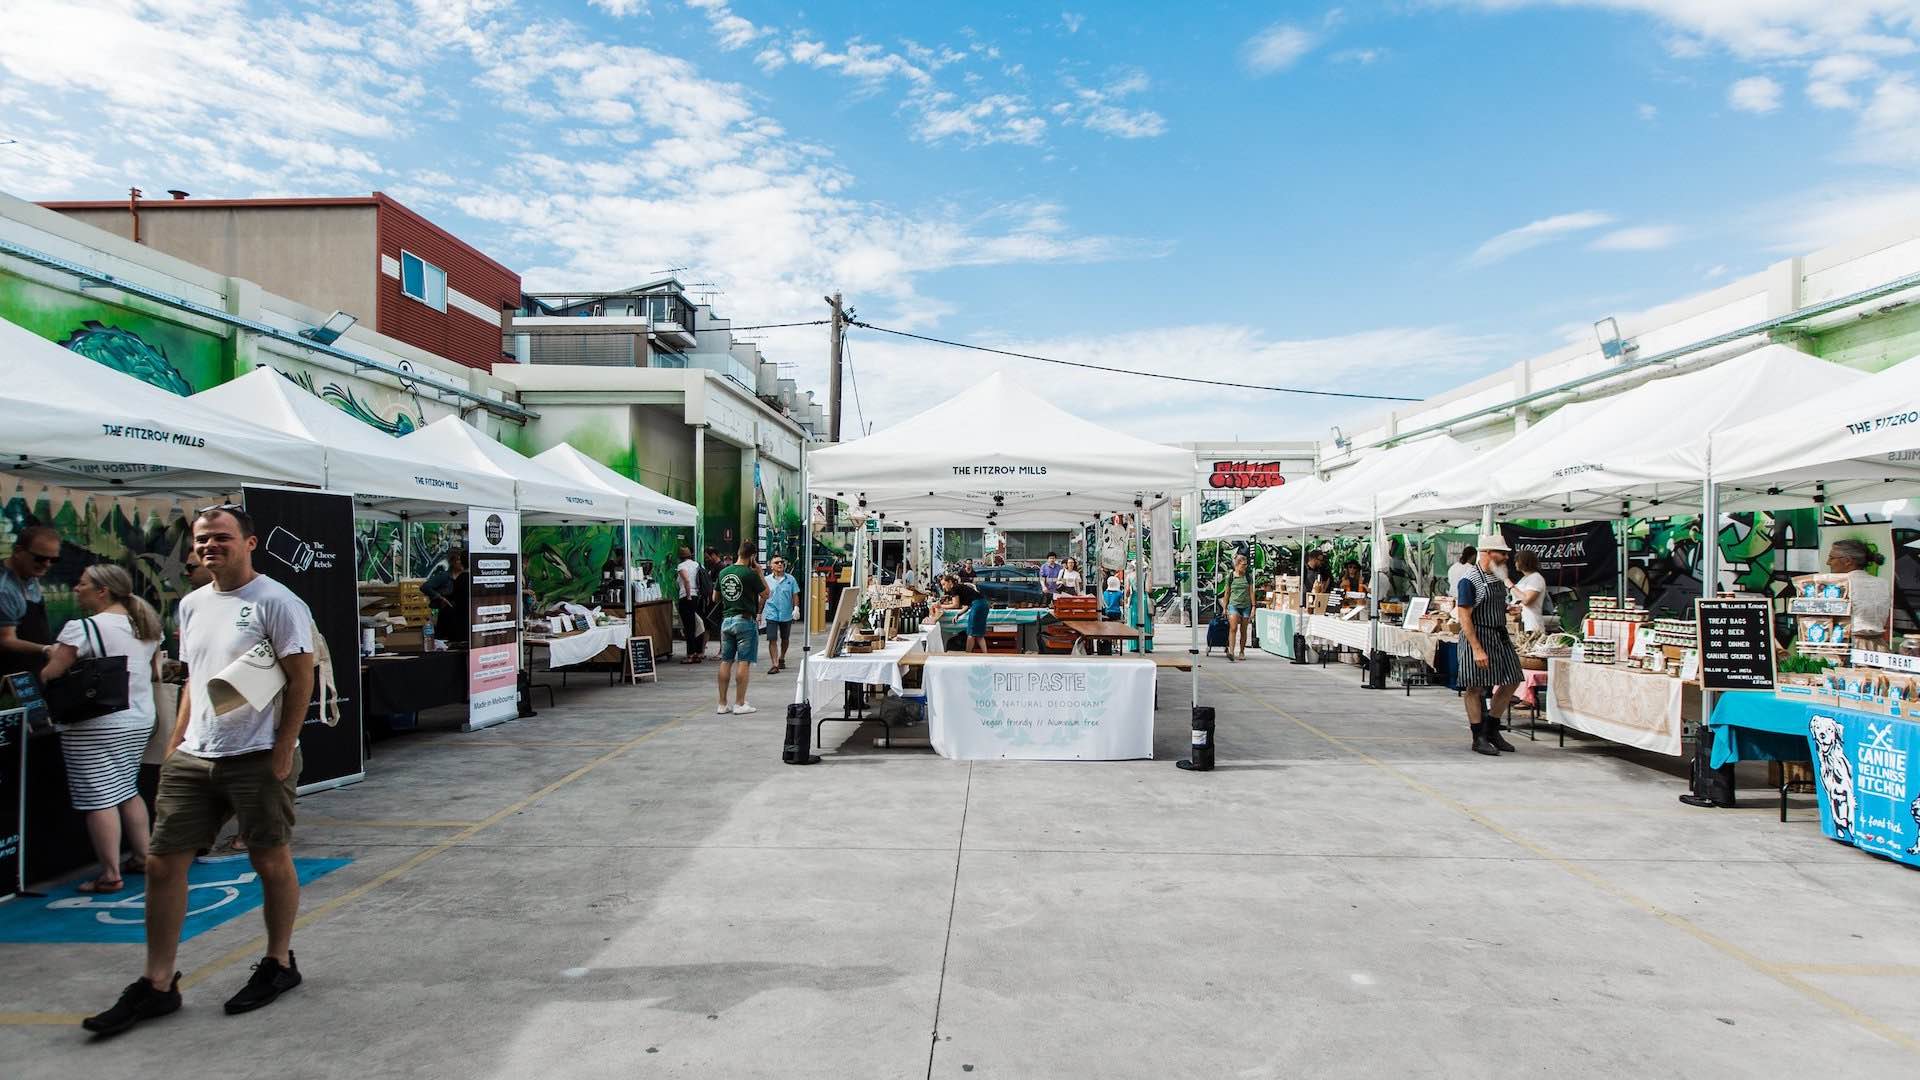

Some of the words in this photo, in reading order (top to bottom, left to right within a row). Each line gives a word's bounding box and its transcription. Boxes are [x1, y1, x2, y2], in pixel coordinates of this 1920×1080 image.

[1846, 421, 1871, 435] THE
[1875, 411, 1920, 431] FITZRO
[102, 424, 122, 437] THE
[125, 426, 169, 441] FITZROY
[172, 433, 205, 448] MILLS
[953, 466, 970, 475] THE
[974, 466, 1015, 475] FITZROY
[1019, 466, 1047, 475] MILLS
[415, 476, 424, 485] THE
[425, 478, 444, 488] FITZROY
[446, 481, 459, 490] MILLS
[313, 541, 324, 549] The
[315, 551, 336, 559] Cheese
[313, 560, 332, 568] Rebels
[1863, 653, 1880, 664] DOG
[1888, 656, 1912, 669] TREAT
[993, 672, 1024, 692] PIT
[1027, 672, 1086, 692] PASTE
[473, 701, 488, 710] Made
[492, 694, 515, 705] Melbourne
[975, 700, 998, 708] 100%
[1002, 700, 1043, 708] NATURAL
[1047, 700, 1105, 708] DEODORANT
[1083, 718, 1100, 727] free
